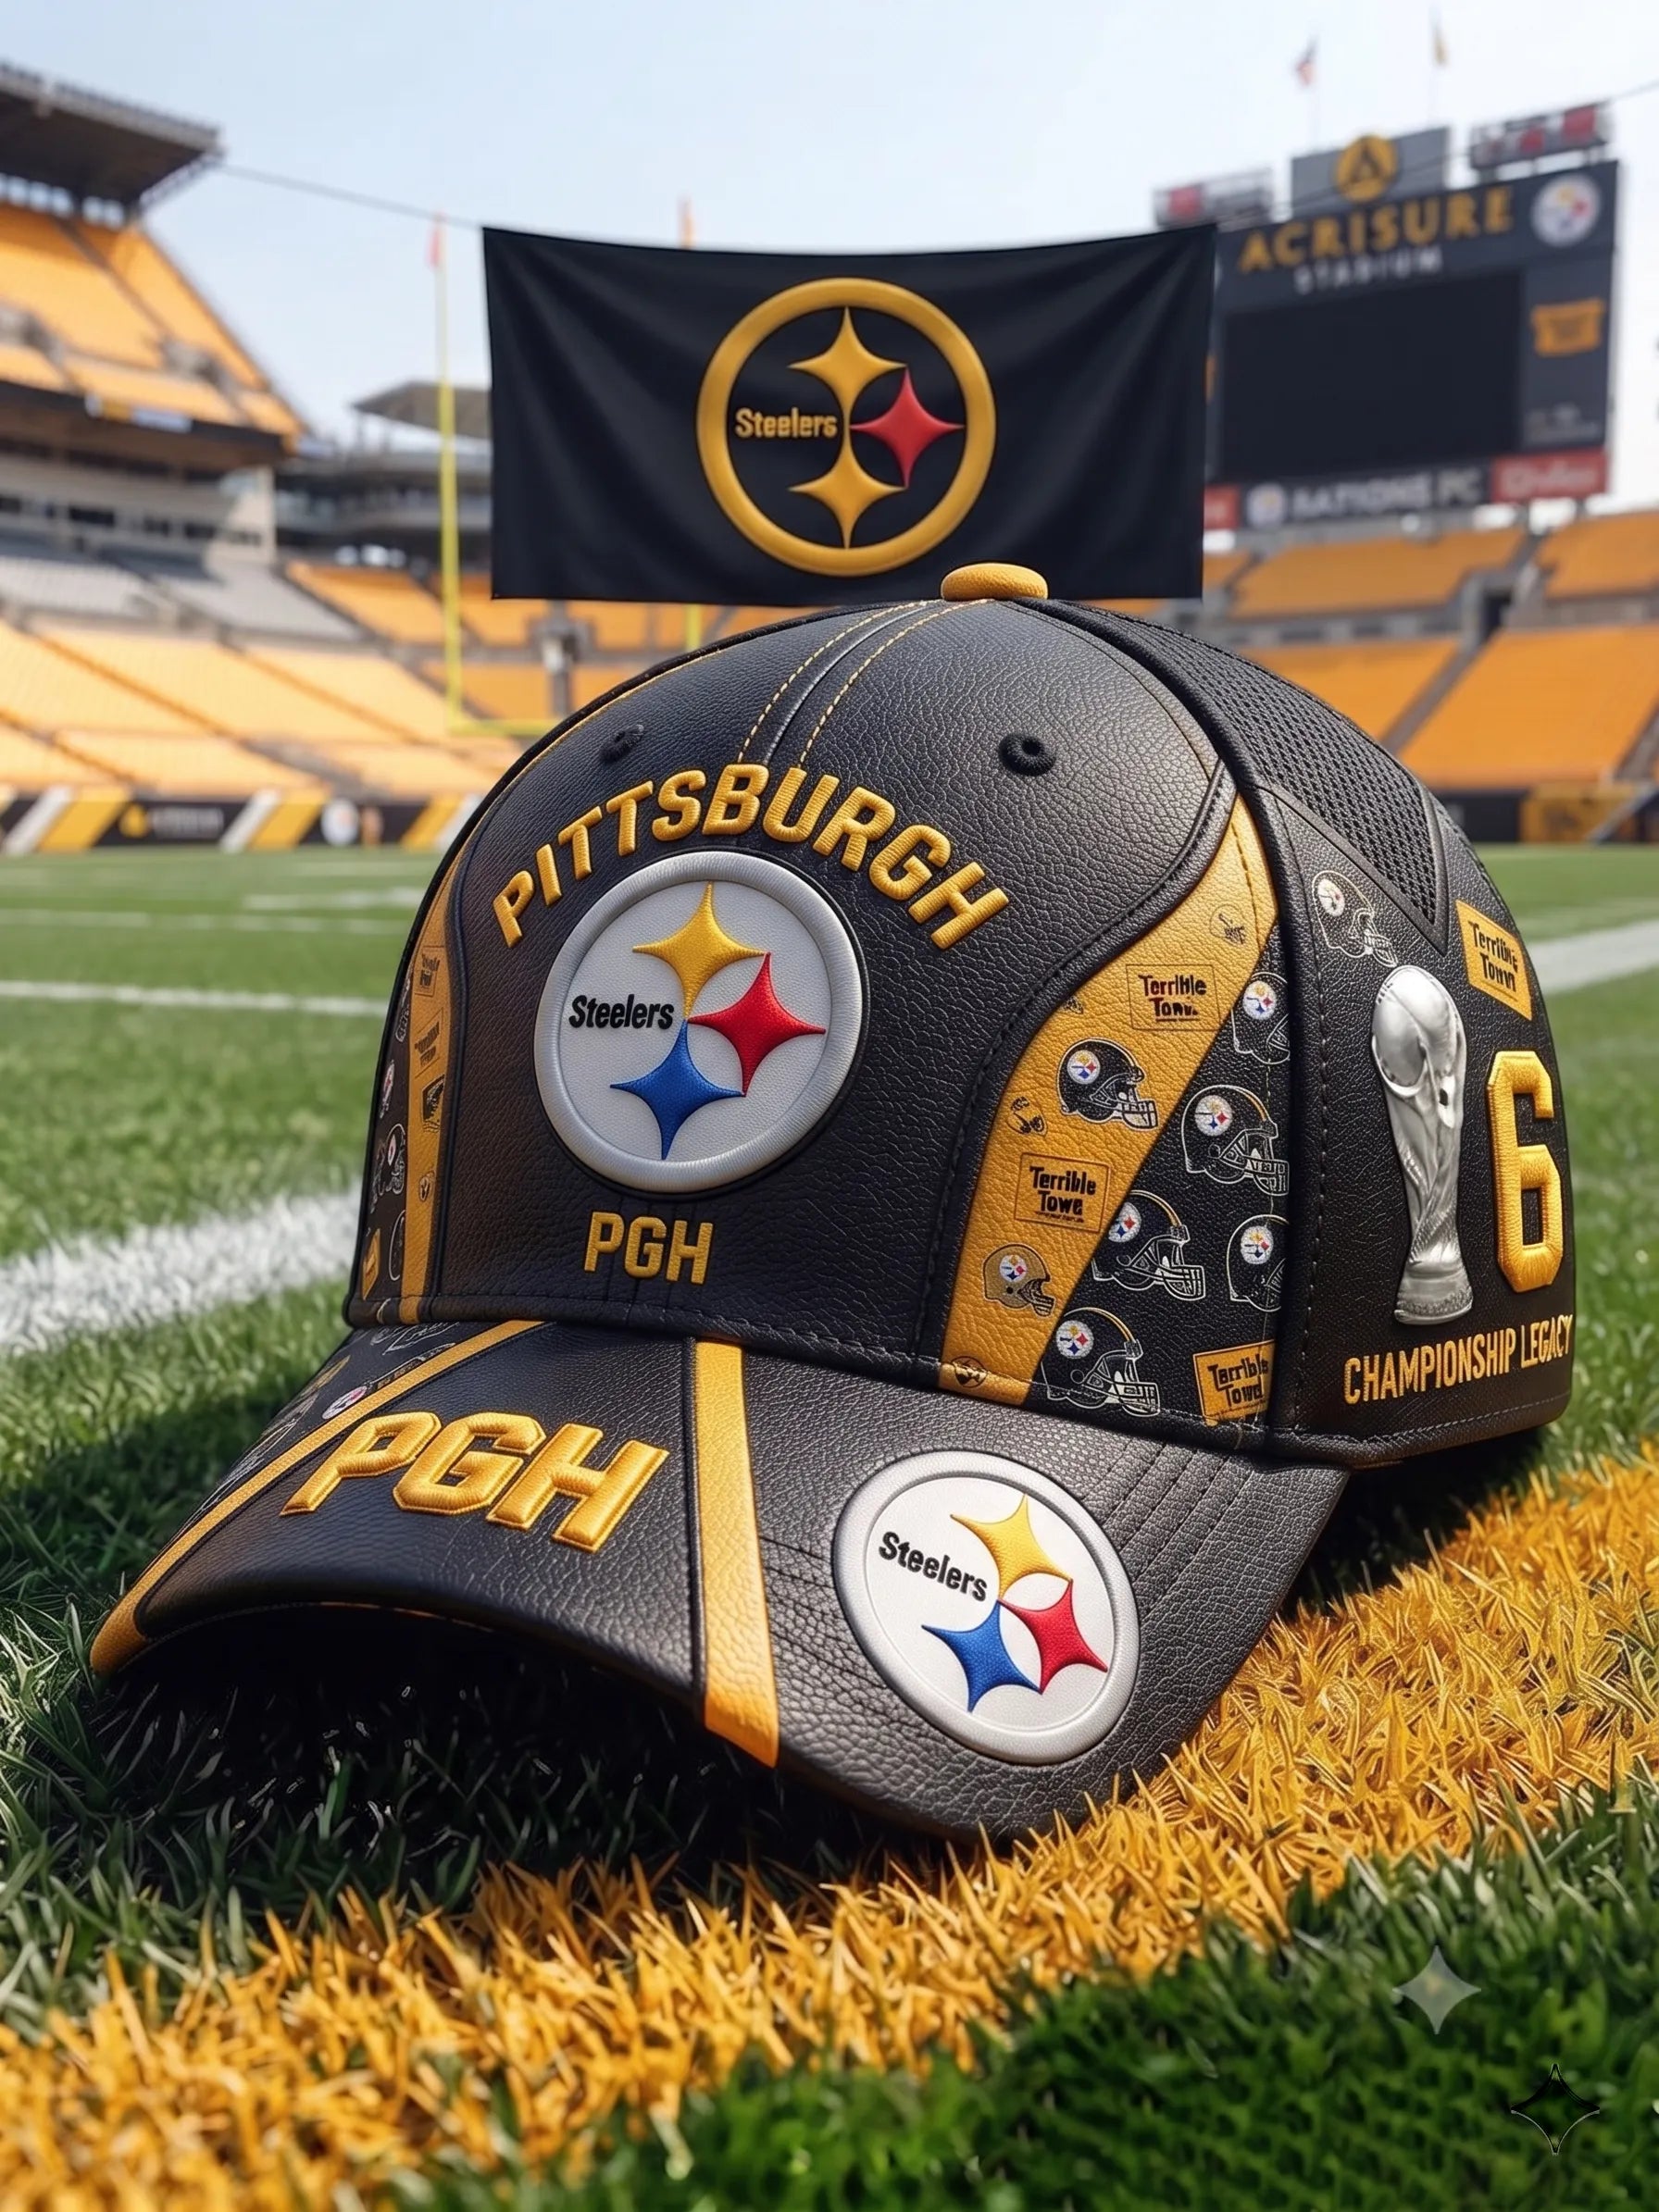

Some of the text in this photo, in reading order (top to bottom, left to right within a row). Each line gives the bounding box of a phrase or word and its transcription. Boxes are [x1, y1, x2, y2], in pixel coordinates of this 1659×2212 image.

[1238, 187, 1514, 272] ACRISURE
[735, 407, 838, 438] Steelers
[492, 764, 1010, 951] PITTSBURGH
[568, 994, 675, 1030] Steelers
[1029, 1165, 1097, 1196] Terrible
[1487, 1050, 1564, 1293] 6
[583, 1211, 715, 1286] PGH
[1343, 1313, 1574, 1405] CHAMPIONSHIP LEGACY
[280, 1411, 670, 1553] PGH
[879, 1531, 988, 1602] Steelers
